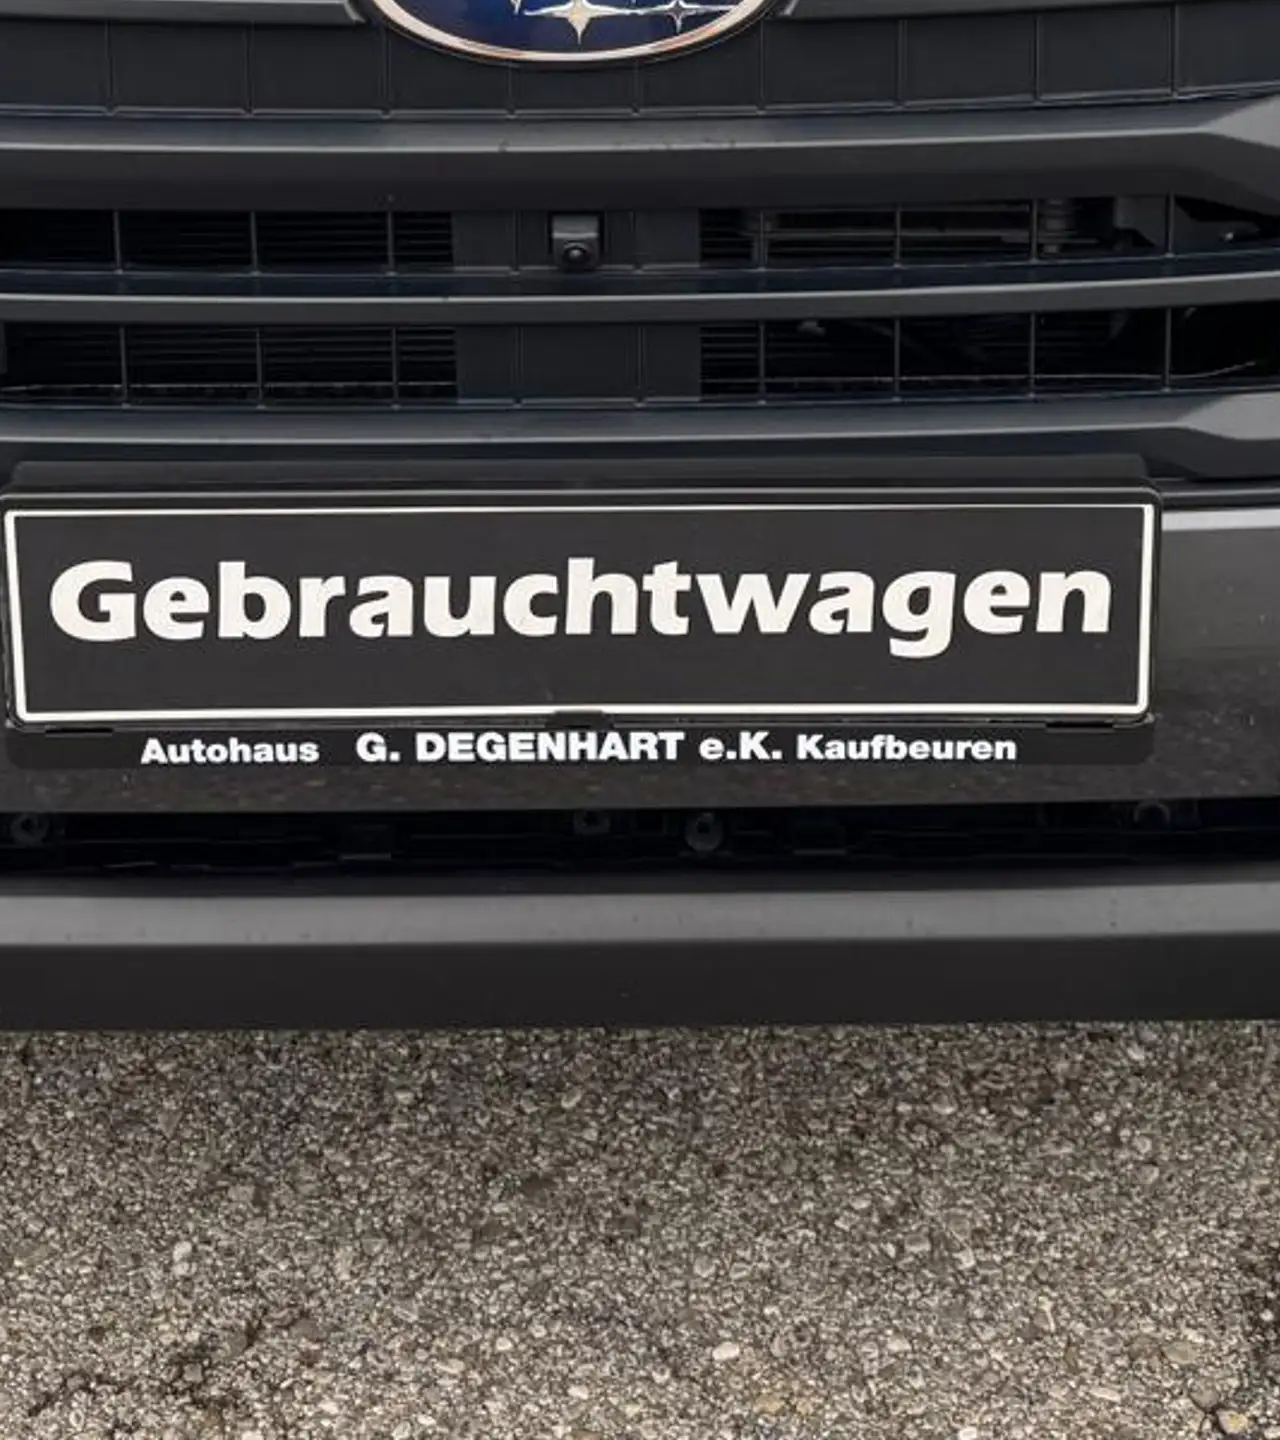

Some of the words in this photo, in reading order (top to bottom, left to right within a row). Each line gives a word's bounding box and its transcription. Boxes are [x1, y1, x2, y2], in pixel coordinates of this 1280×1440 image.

[49, 556, 1111, 658] Gebrauchtwagen
[140, 734, 320, 765] Autohaus
[355, 731, 401, 763] G.
[415, 730, 686, 762] DEGENHART
[699, 730, 783, 761] e.K.
[796, 732, 1017, 760] Kaufbeuren
